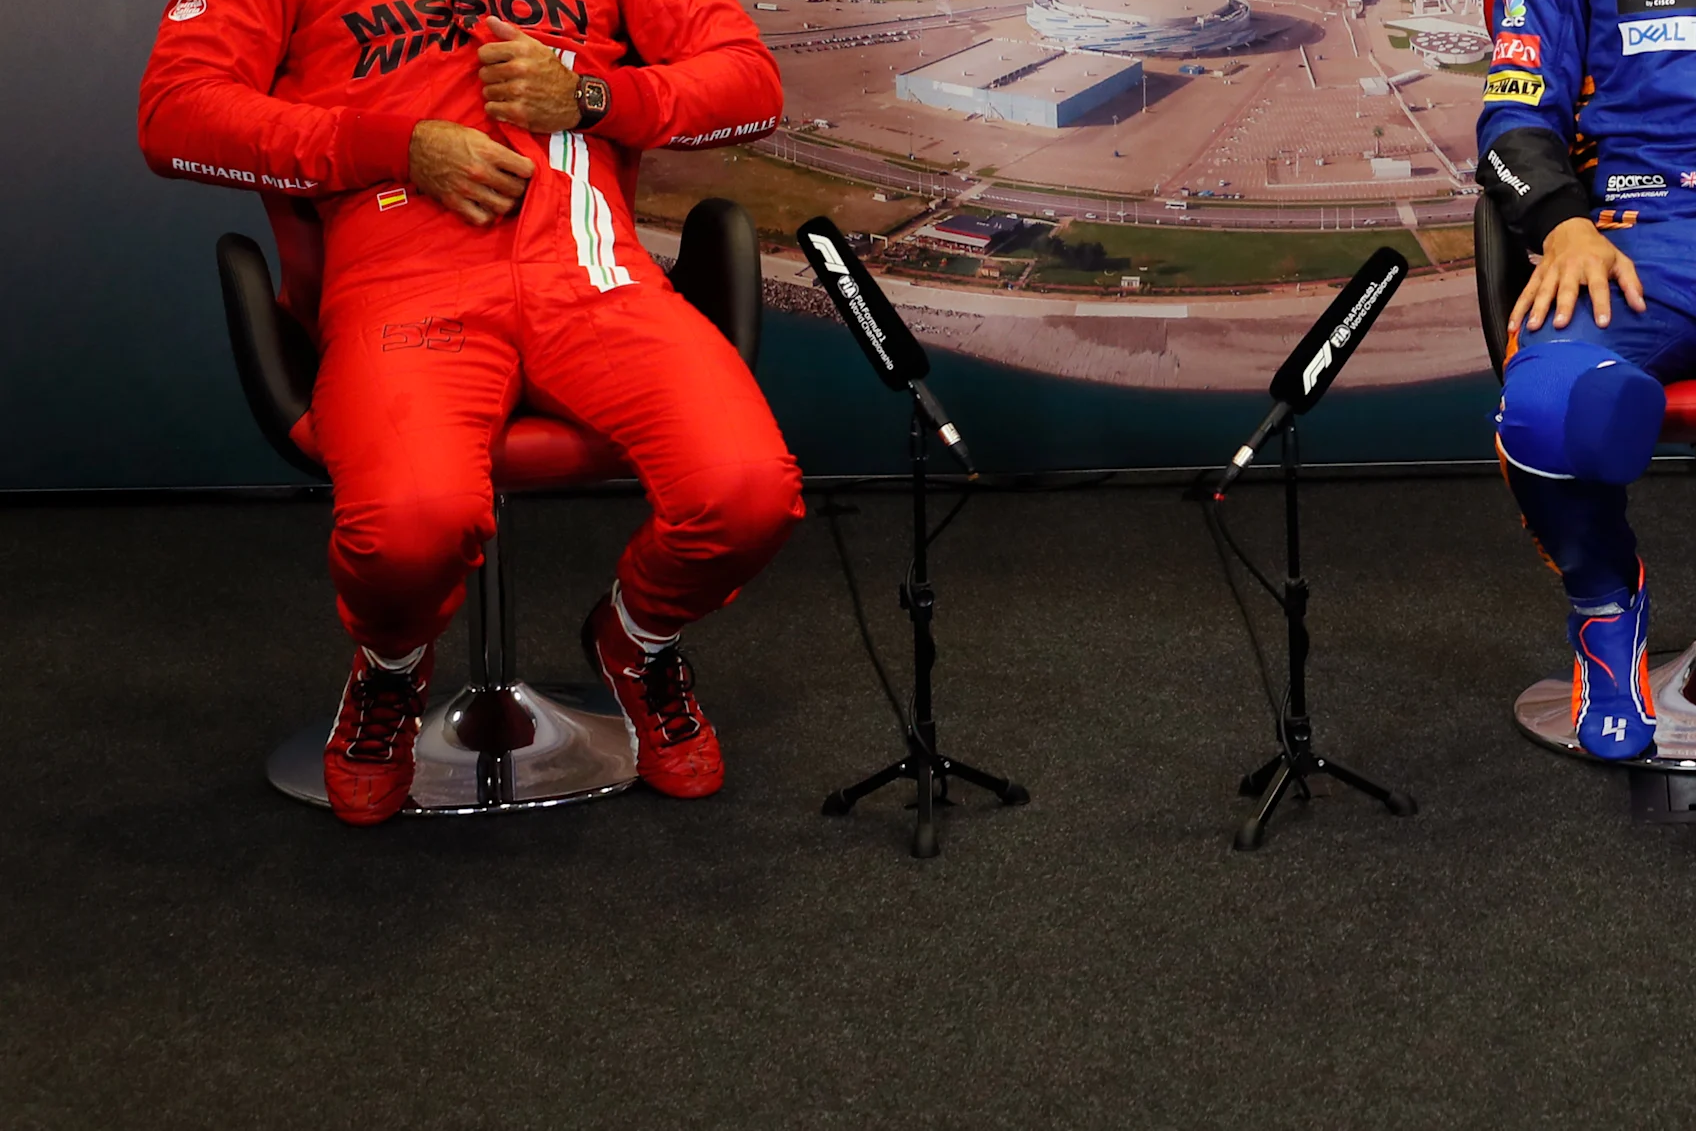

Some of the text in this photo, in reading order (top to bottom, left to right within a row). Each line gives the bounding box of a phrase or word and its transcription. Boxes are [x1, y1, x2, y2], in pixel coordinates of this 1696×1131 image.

[1628, 22, 1686, 46] DELL
[734, 116, 776, 137] MILLE
[172, 157, 256, 183] RICHARD
[1606, 174, 1667, 192] sparco
